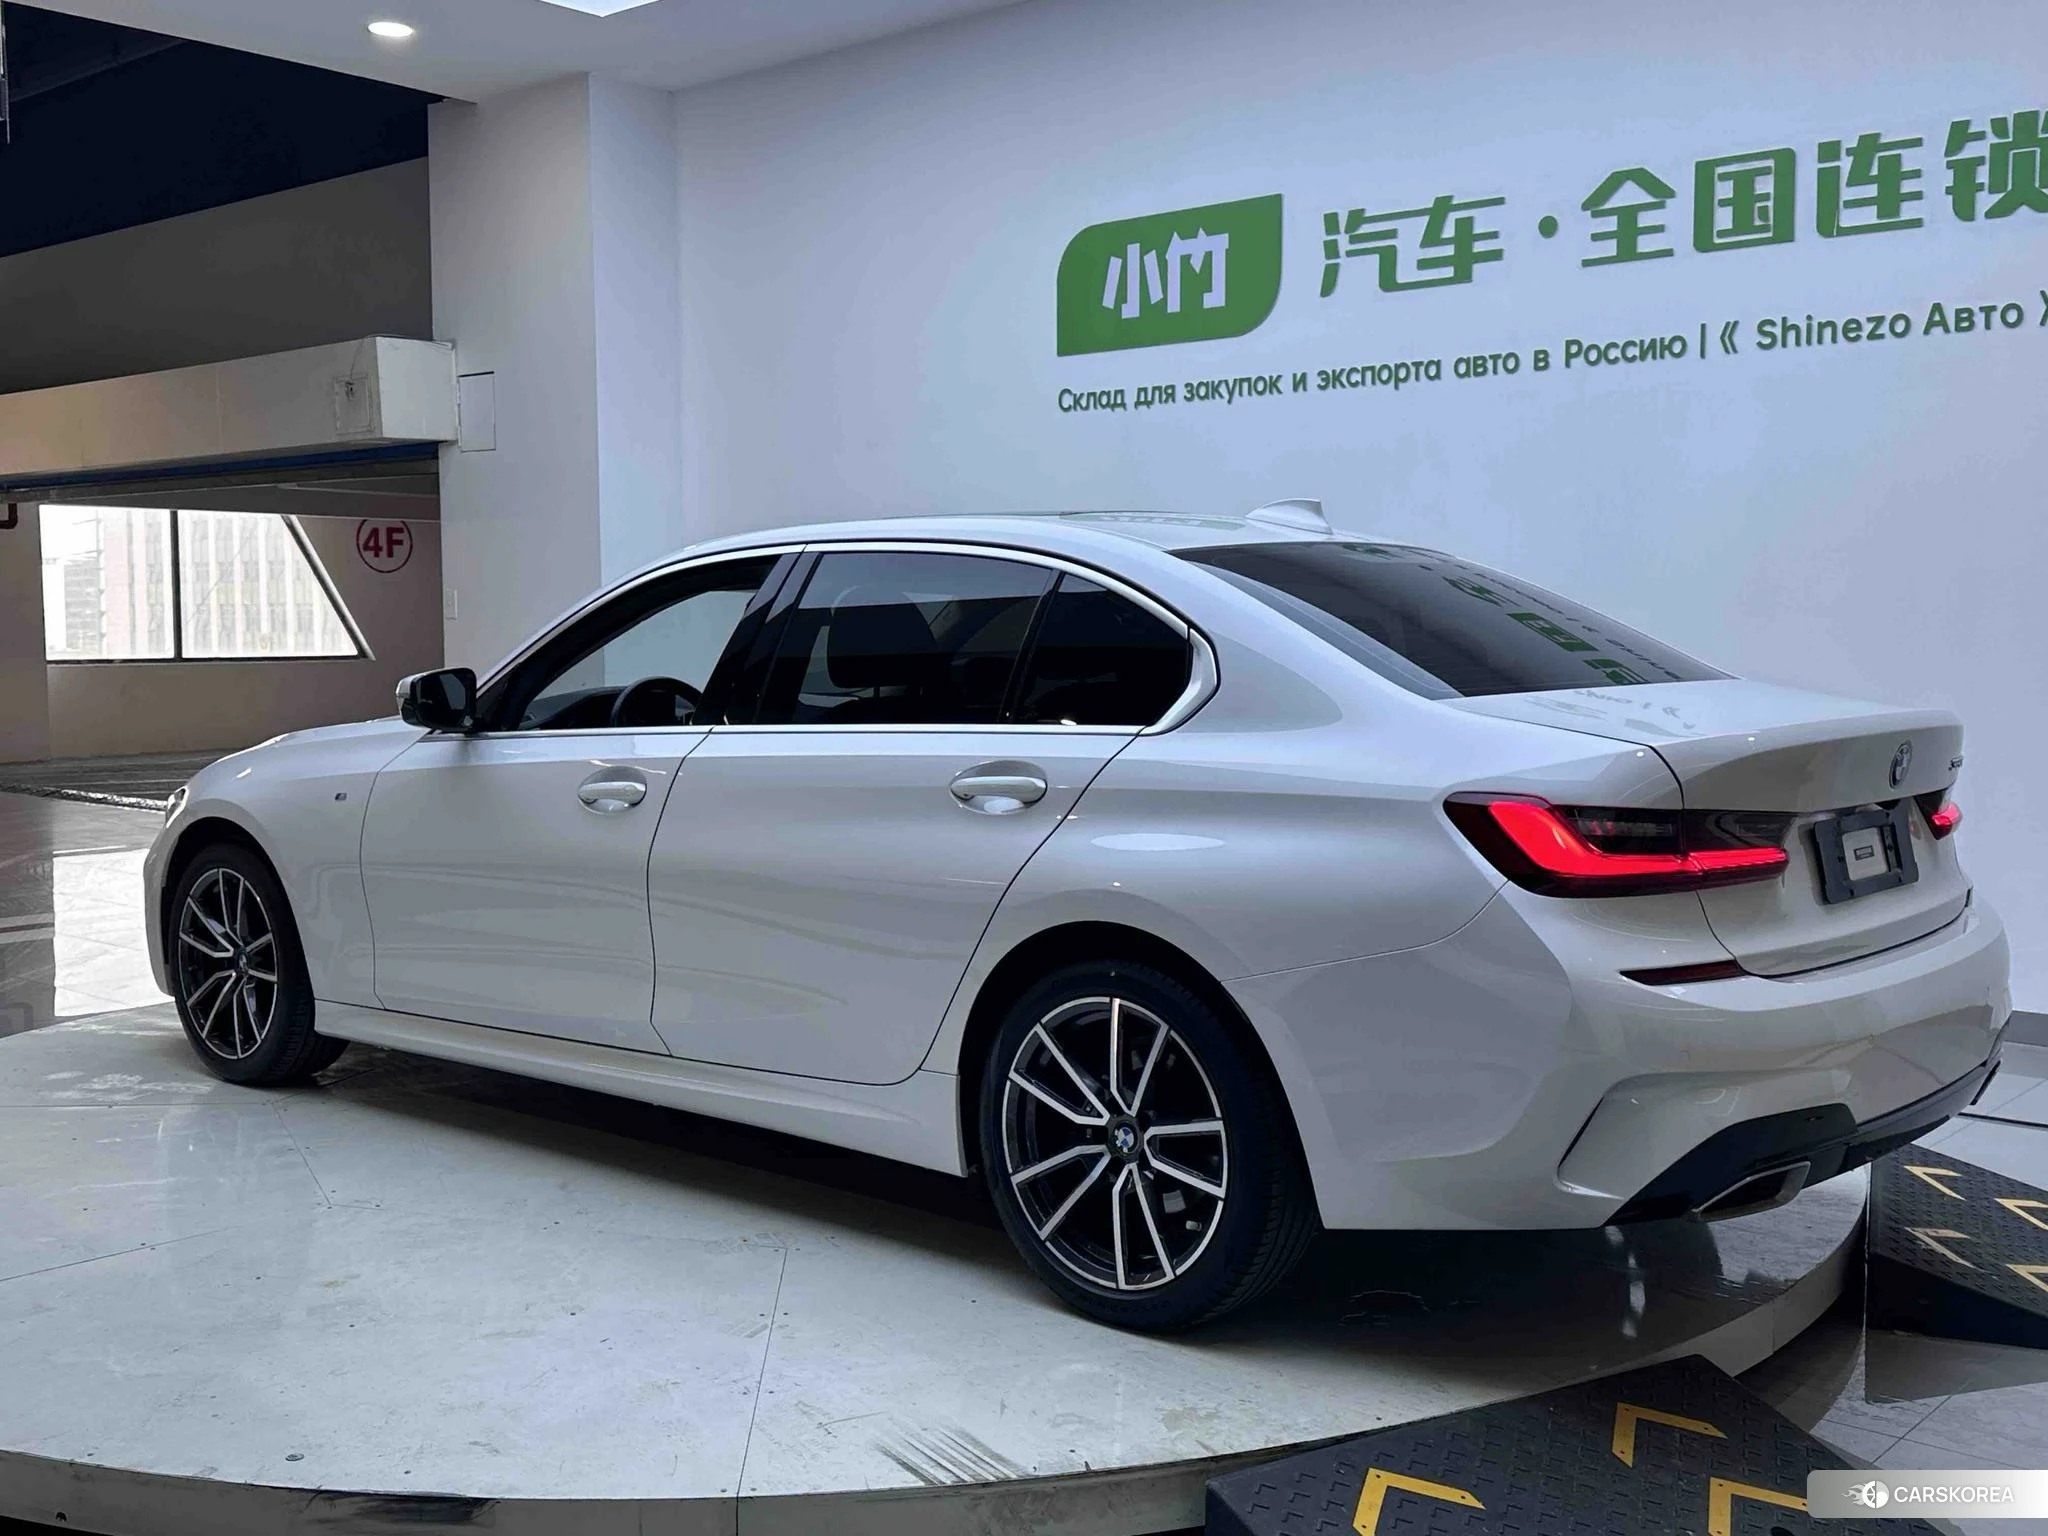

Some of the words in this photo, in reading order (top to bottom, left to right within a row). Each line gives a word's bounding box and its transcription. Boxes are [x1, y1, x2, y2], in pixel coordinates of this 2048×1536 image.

[1102, 228, 1229, 319] 小竹
[1058, 388, 1127, 413] Склад
[1134, 384, 1177, 410] для
[1184, 374, 1283, 405] закупок
[1293, 371, 1308, 393] и
[1317, 359, 1442, 391] экспорта
[1454, 351, 1521, 379] авто
[1533, 349, 1551, 372] в
[1564, 334, 1687, 369] Россию
[1756, 313, 1912, 350] Shinezo
[1923, 302, 2024, 336] Авто
[363, 527, 404, 558] 4F
